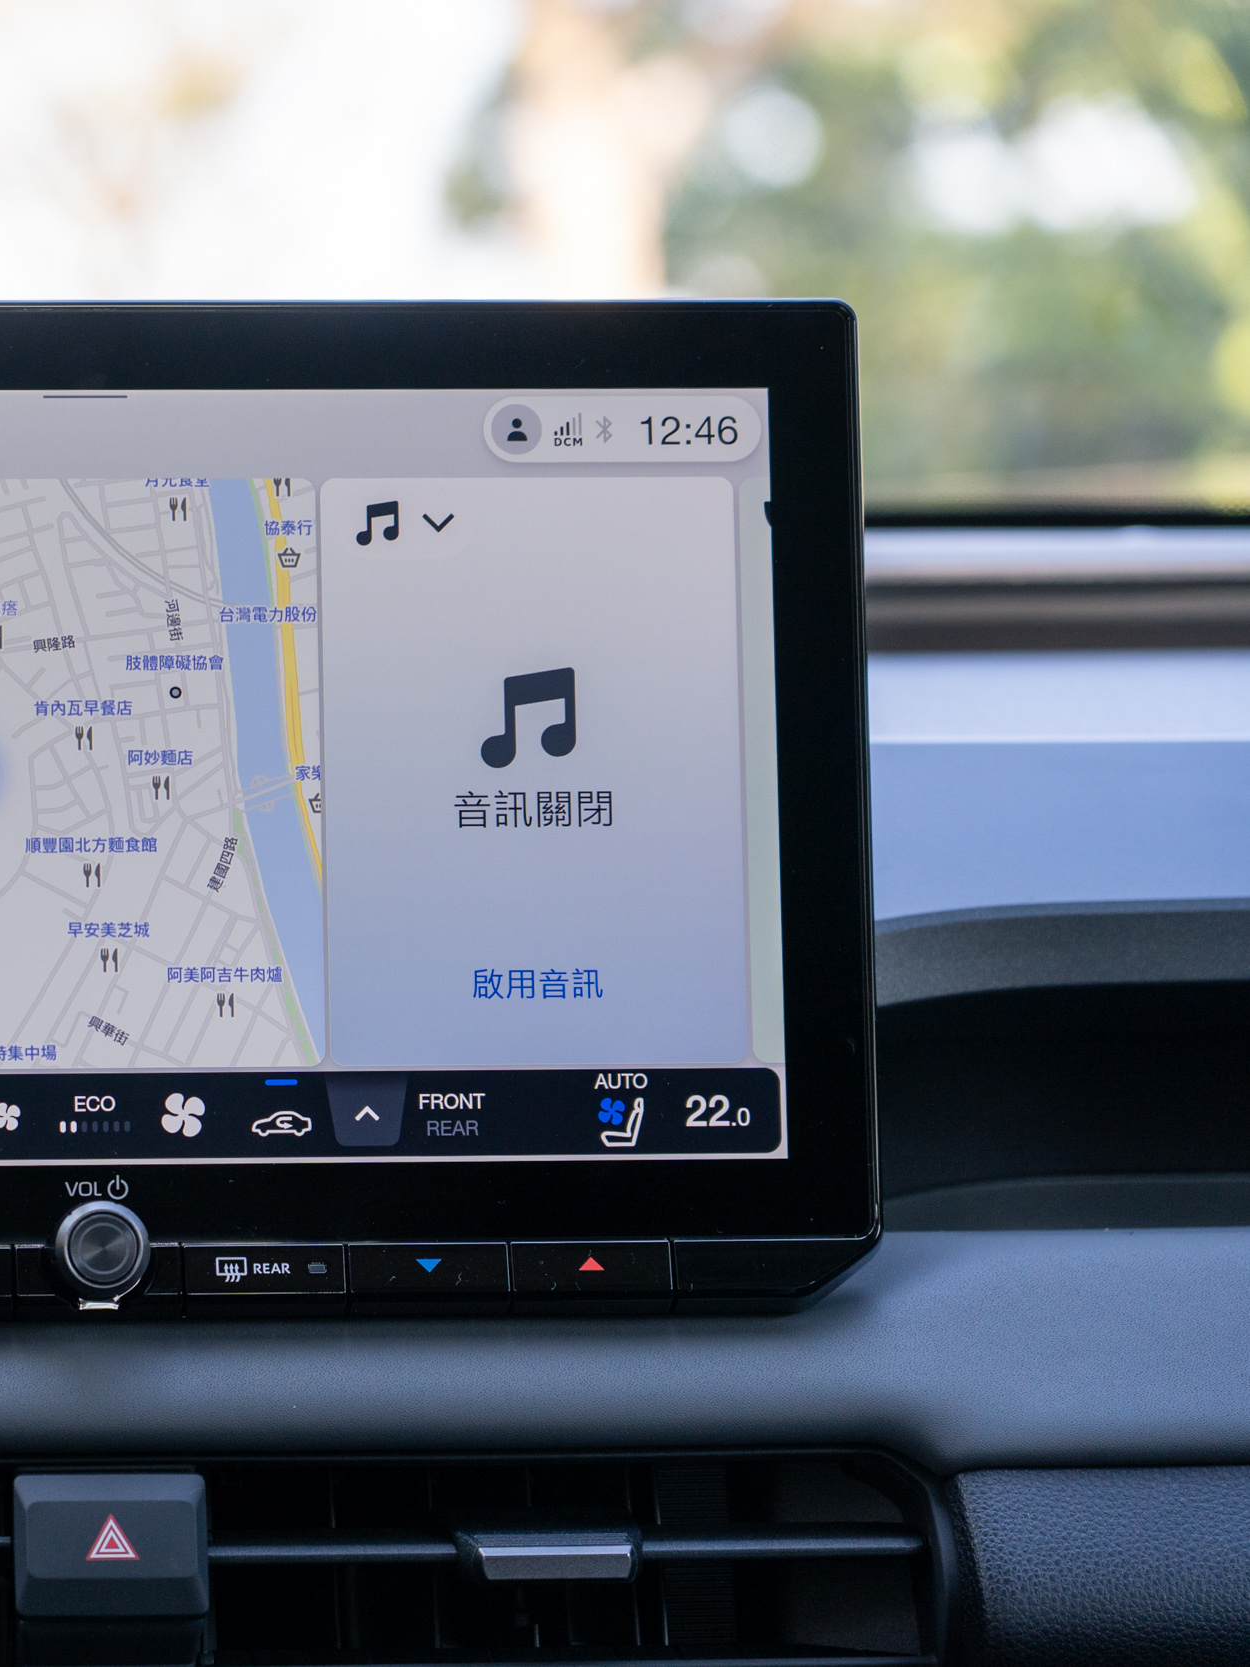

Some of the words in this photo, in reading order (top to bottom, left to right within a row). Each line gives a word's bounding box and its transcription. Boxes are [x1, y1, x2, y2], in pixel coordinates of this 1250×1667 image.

[640, 415, 739, 446] 12:46
[553, 437, 583, 447] DCM
[264, 519, 313, 536] 協泰行
[164, 599, 184, 642] 河邊街
[219, 606, 317, 623] 台灣電力股份
[33, 635, 76, 653] 興隆路
[125, 655, 224, 671] 肢體障礙協會
[34, 700, 133, 716] 肯內瓦早餐店
[127, 750, 193, 766] 阿妙麵店
[454, 790, 613, 828] 音訊關閉
[25, 836, 158, 853] 順豐園北方麵食館
[207, 836, 238, 893] 建國四路
[67, 922, 150, 938] 早安美芝城
[167, 966, 283, 983] 阿美阿吉牛肉爐
[472, 968, 603, 999] 啟用音訊
[87, 1015, 130, 1046] 興華街
[595, 1073, 648, 1090] AUTO
[73, 1095, 116, 1112] ECO
[418, 1093, 486, 1110] FRONT
[685, 1095, 751, 1128] 22.0
[426, 1120, 479, 1137] REAR
[64, 1180, 102, 1197] VOL
[252, 1263, 291, 1275] REAR
